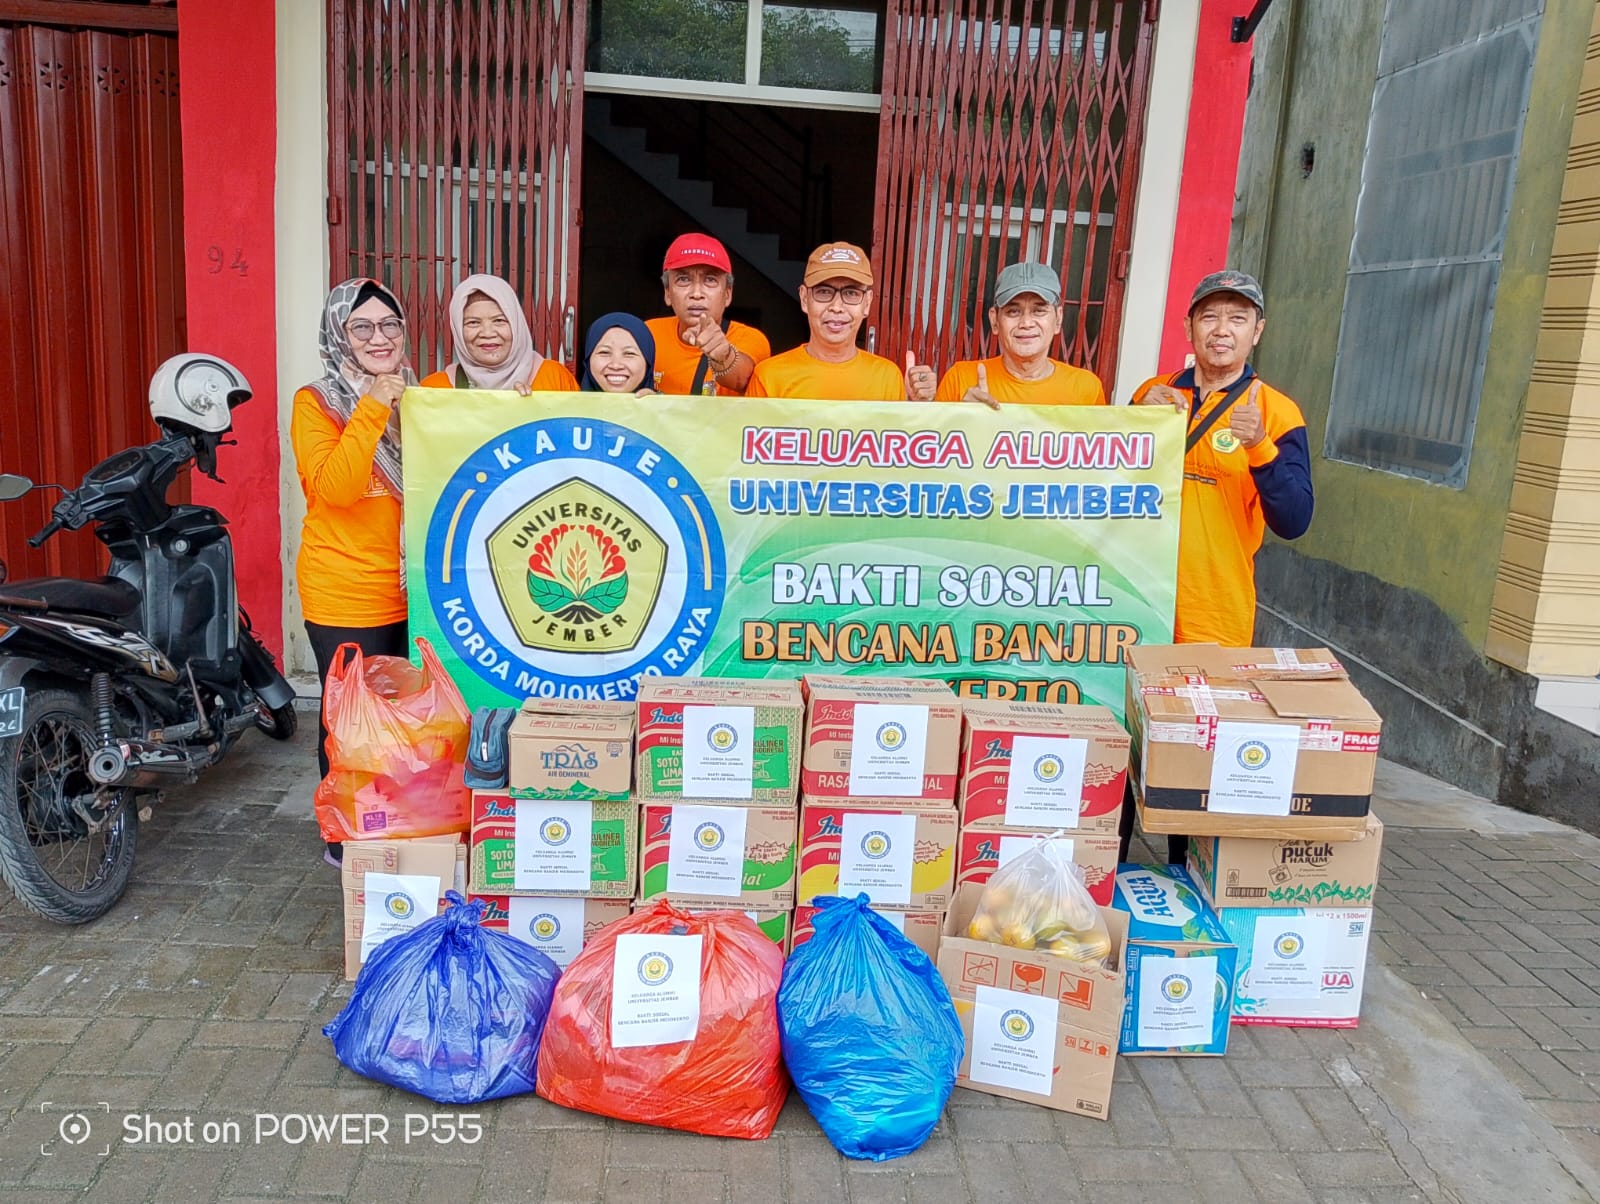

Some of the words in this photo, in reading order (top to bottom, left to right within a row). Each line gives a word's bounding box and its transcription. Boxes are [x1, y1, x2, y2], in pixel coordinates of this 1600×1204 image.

[207, 246, 249, 278] 94
[494, 426, 661, 477] KAUJE
[742, 426, 973, 468] KELUARGA
[985, 431, 1155, 470] ALUMNI
[728, 478, 994, 519] UNIVERSITAS
[1001, 483, 1164, 519] JEMBER
[512, 502, 643, 554] UNIVERSITAS
[772, 562, 921, 607] BAKTI
[937, 564, 1113, 607] SOSIAL
[442, 598, 510, 682] KORDA
[662, 606, 713, 670] RAYA
[532, 613, 628, 643] JEMBER
[741, 620, 961, 665] BENCANA
[972, 621, 1143, 665] BANJIR
[540, 751, 599, 770] TRAS
[1281, 842, 1334, 864] pucuk
[1289, 856, 1329, 864] HARUM
[1126, 876, 1175, 919] AQUA
